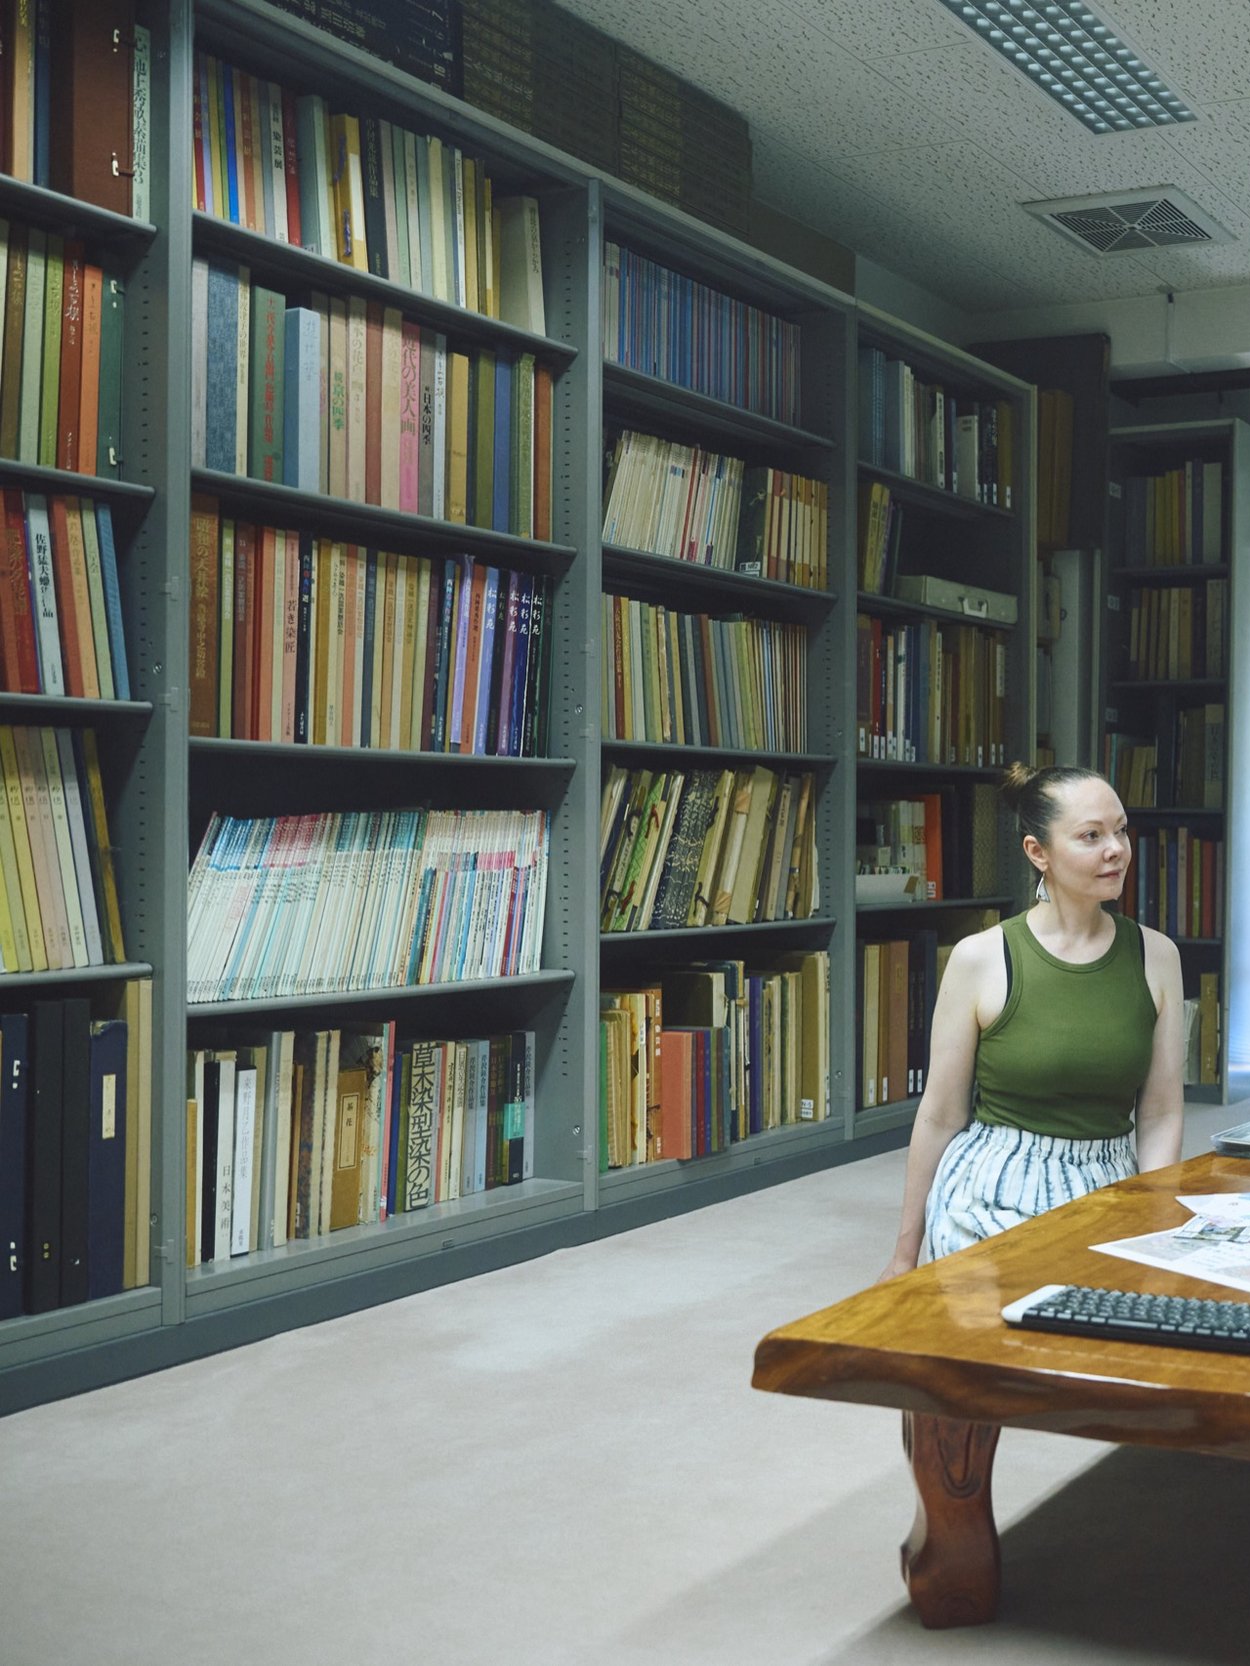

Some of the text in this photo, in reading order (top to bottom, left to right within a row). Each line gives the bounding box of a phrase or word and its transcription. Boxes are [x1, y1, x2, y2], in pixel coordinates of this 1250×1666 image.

[407, 1043, 433, 1208] 草木染型染の色
